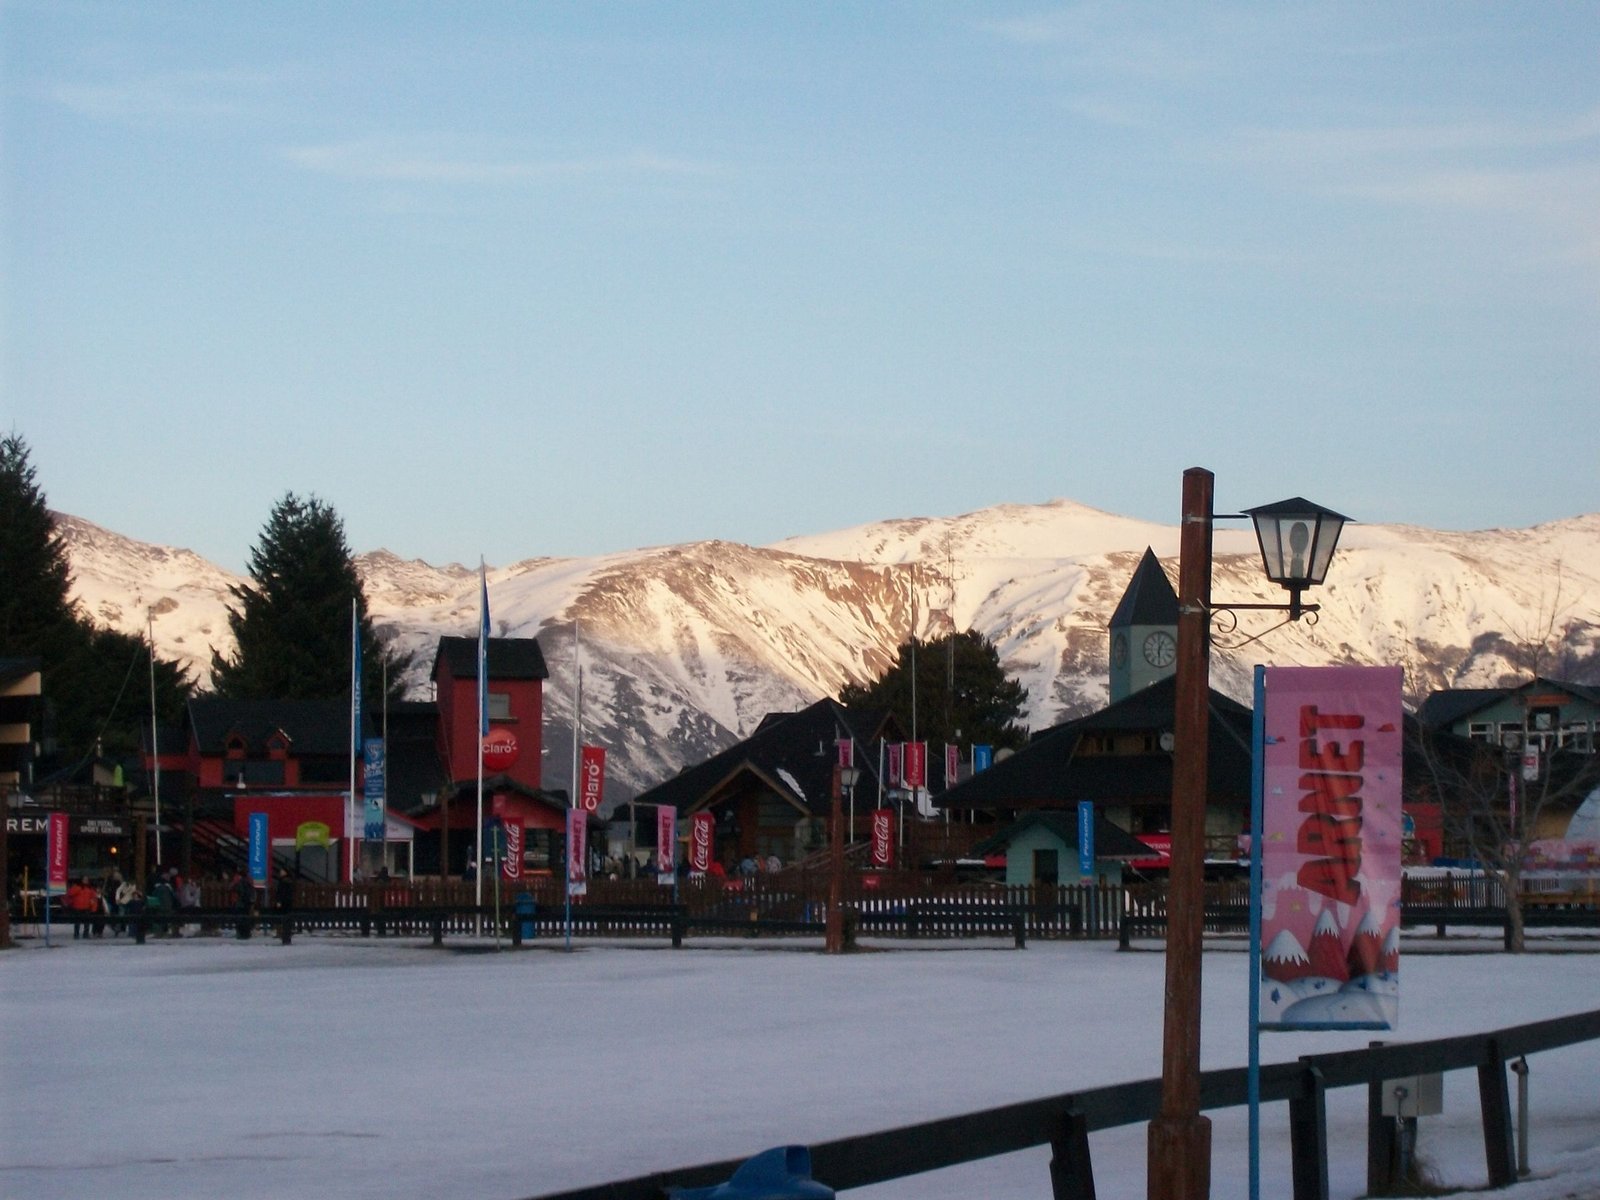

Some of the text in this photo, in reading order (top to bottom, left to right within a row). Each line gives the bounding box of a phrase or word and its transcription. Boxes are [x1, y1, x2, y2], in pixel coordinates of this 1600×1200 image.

[482, 743, 512, 754] Claro
[585, 765, 600, 811] Claro
[1297, 705, 1365, 908] ARNET
[55, 819, 63, 867] Personal
